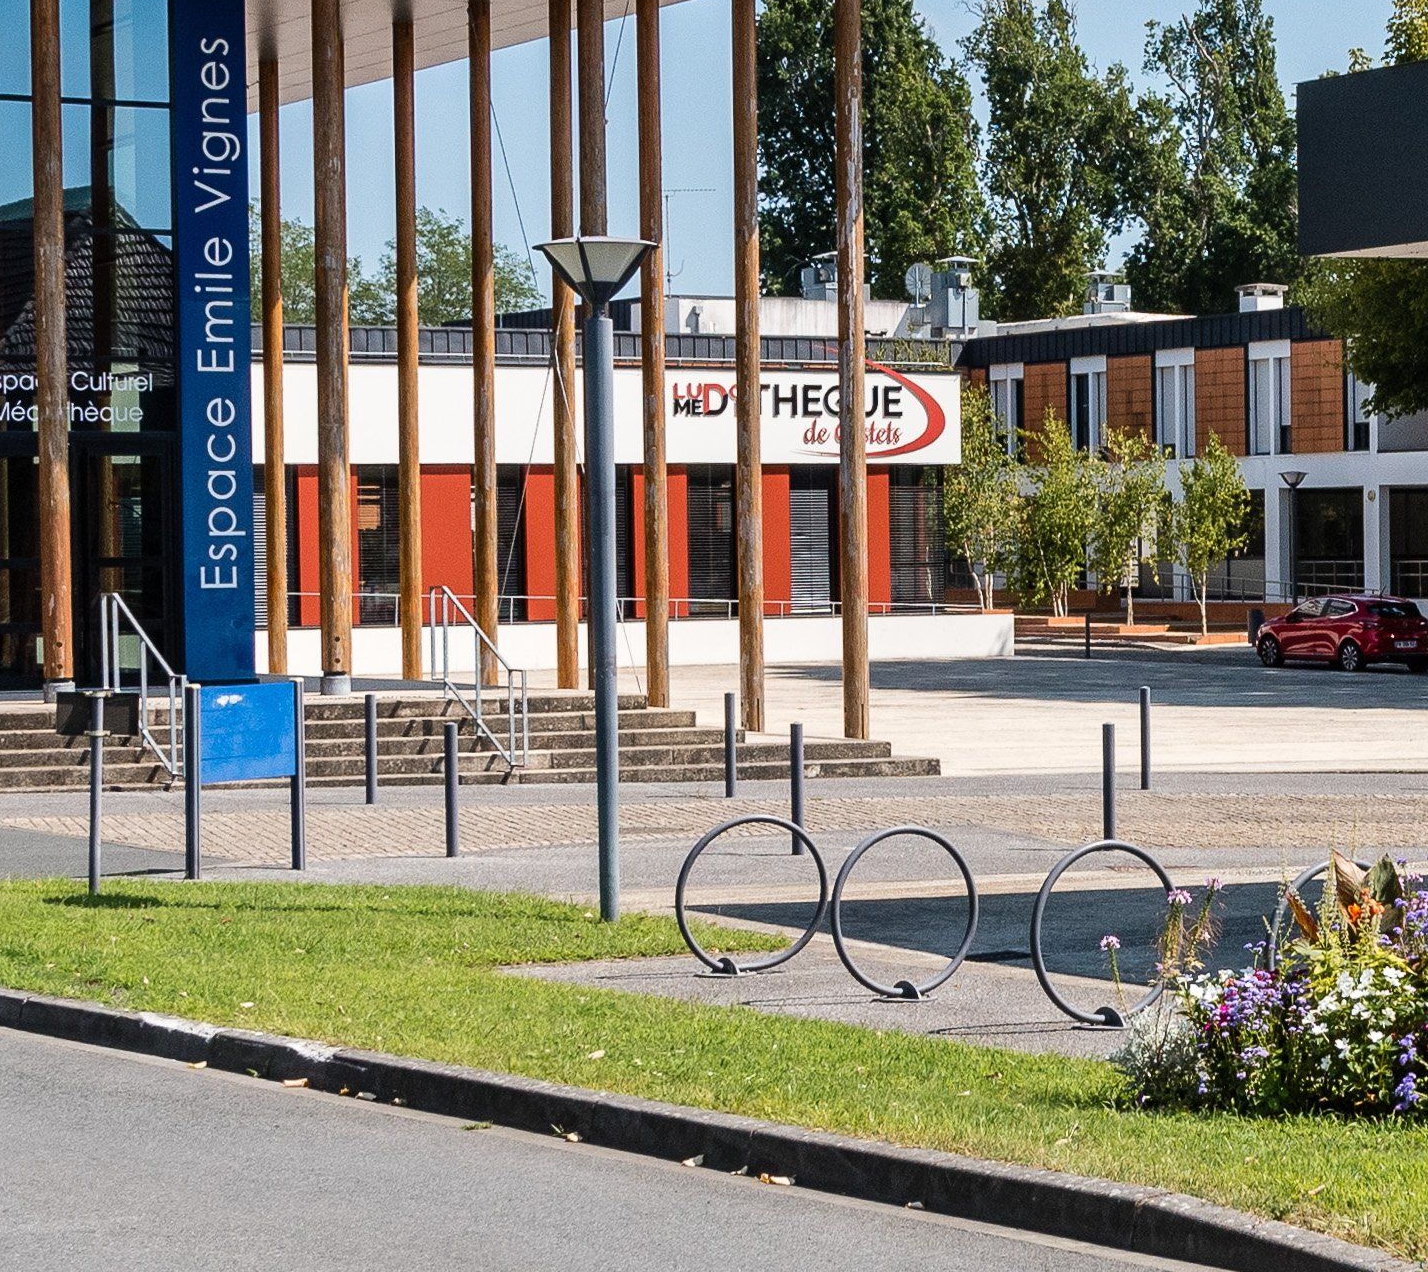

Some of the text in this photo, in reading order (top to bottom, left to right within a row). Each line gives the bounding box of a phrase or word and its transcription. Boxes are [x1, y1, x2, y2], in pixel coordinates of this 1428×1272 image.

[193, 36, 246, 590] Espace Emile Vignes
[71, 371, 153, 392] Culturel
[803, 418, 831, 445] de
